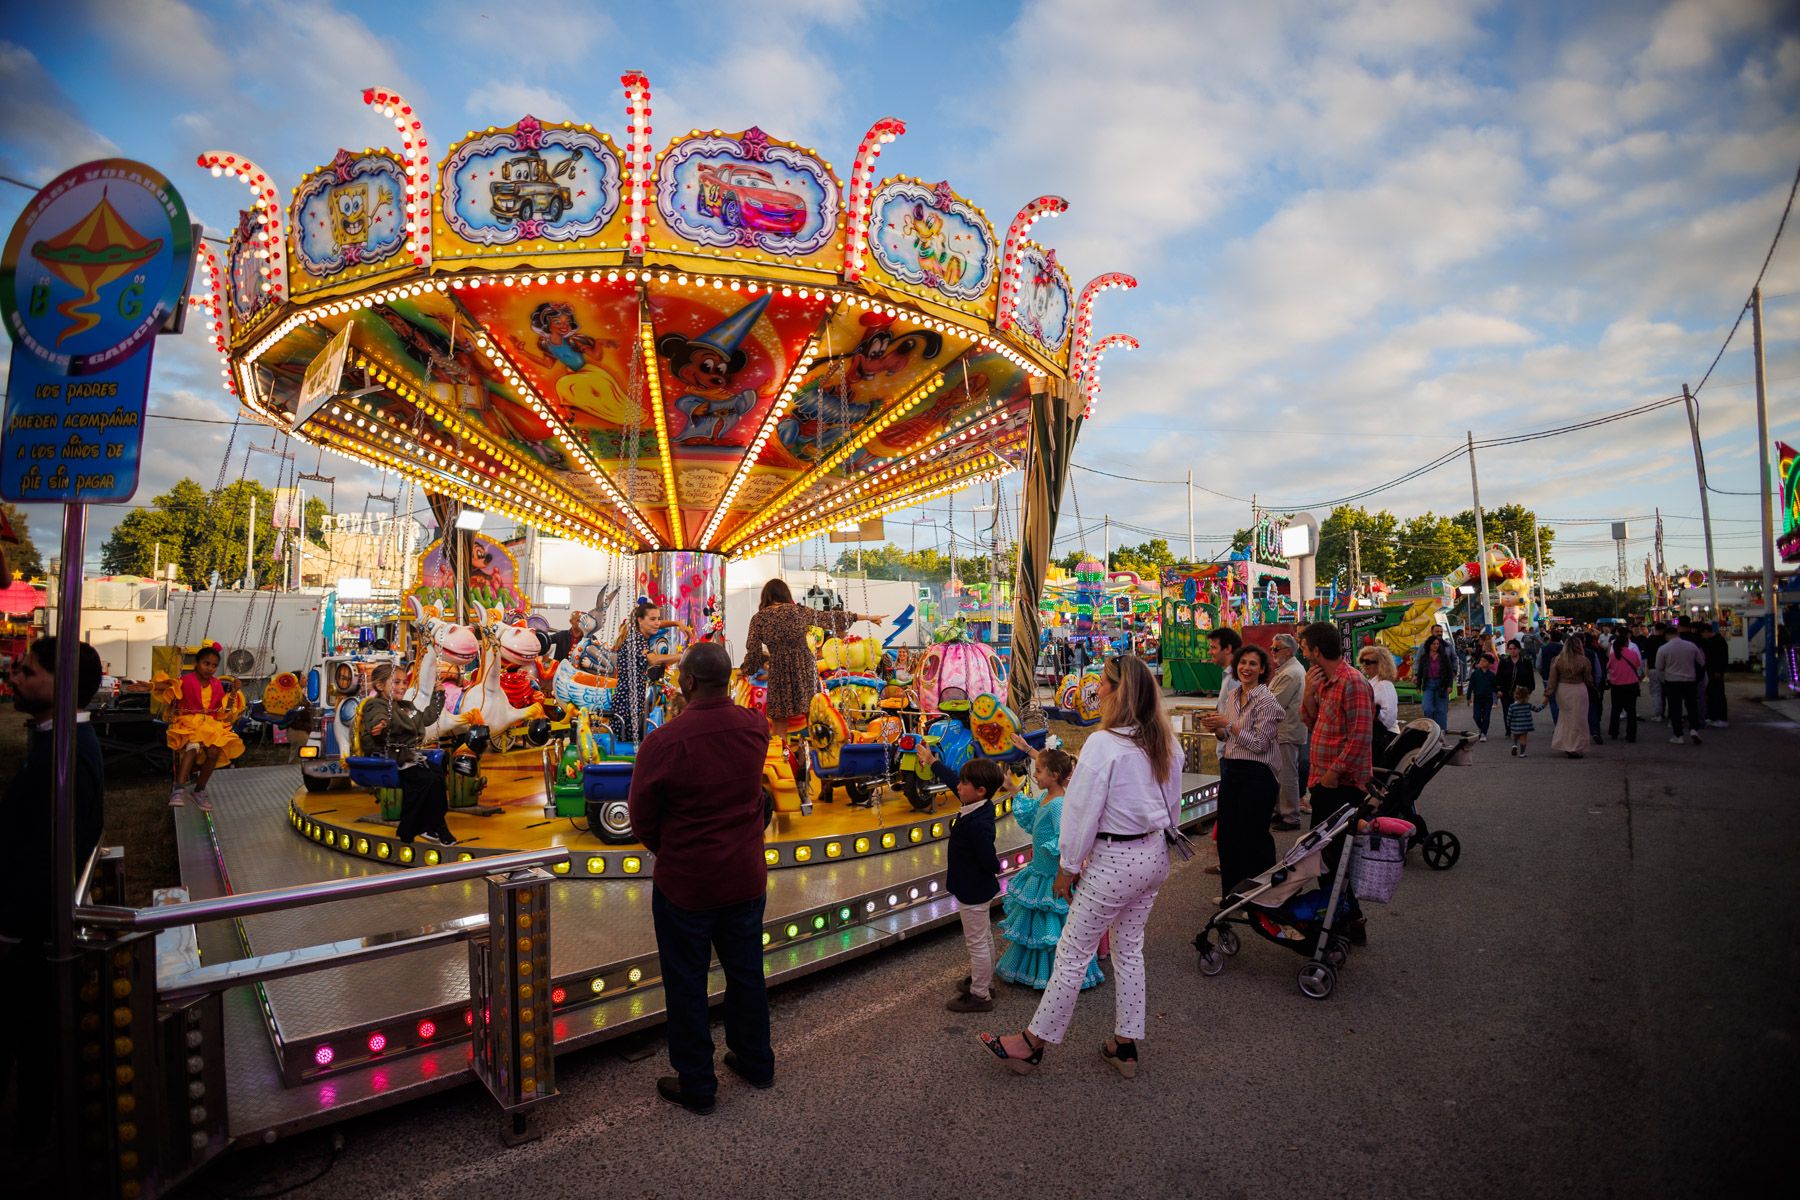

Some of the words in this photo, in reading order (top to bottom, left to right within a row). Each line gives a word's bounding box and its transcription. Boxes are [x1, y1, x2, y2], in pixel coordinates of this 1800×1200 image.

[25, 177, 77, 226] BABY
[85, 169, 178, 218] VOLADOR
[30, 284, 50, 318] B
[118, 284, 145, 320] G
[89, 302, 166, 366] GARCIA
[67, 383, 118, 405] PADRES
[10, 414, 58, 436] PUEDEN
[64, 406, 138, 435] ACOMPAÑAR
[17, 445, 26, 459] A
[31, 445, 56, 459] LOS
[107, 443, 125, 458] DE
[76, 474, 115, 497] PAGAR
